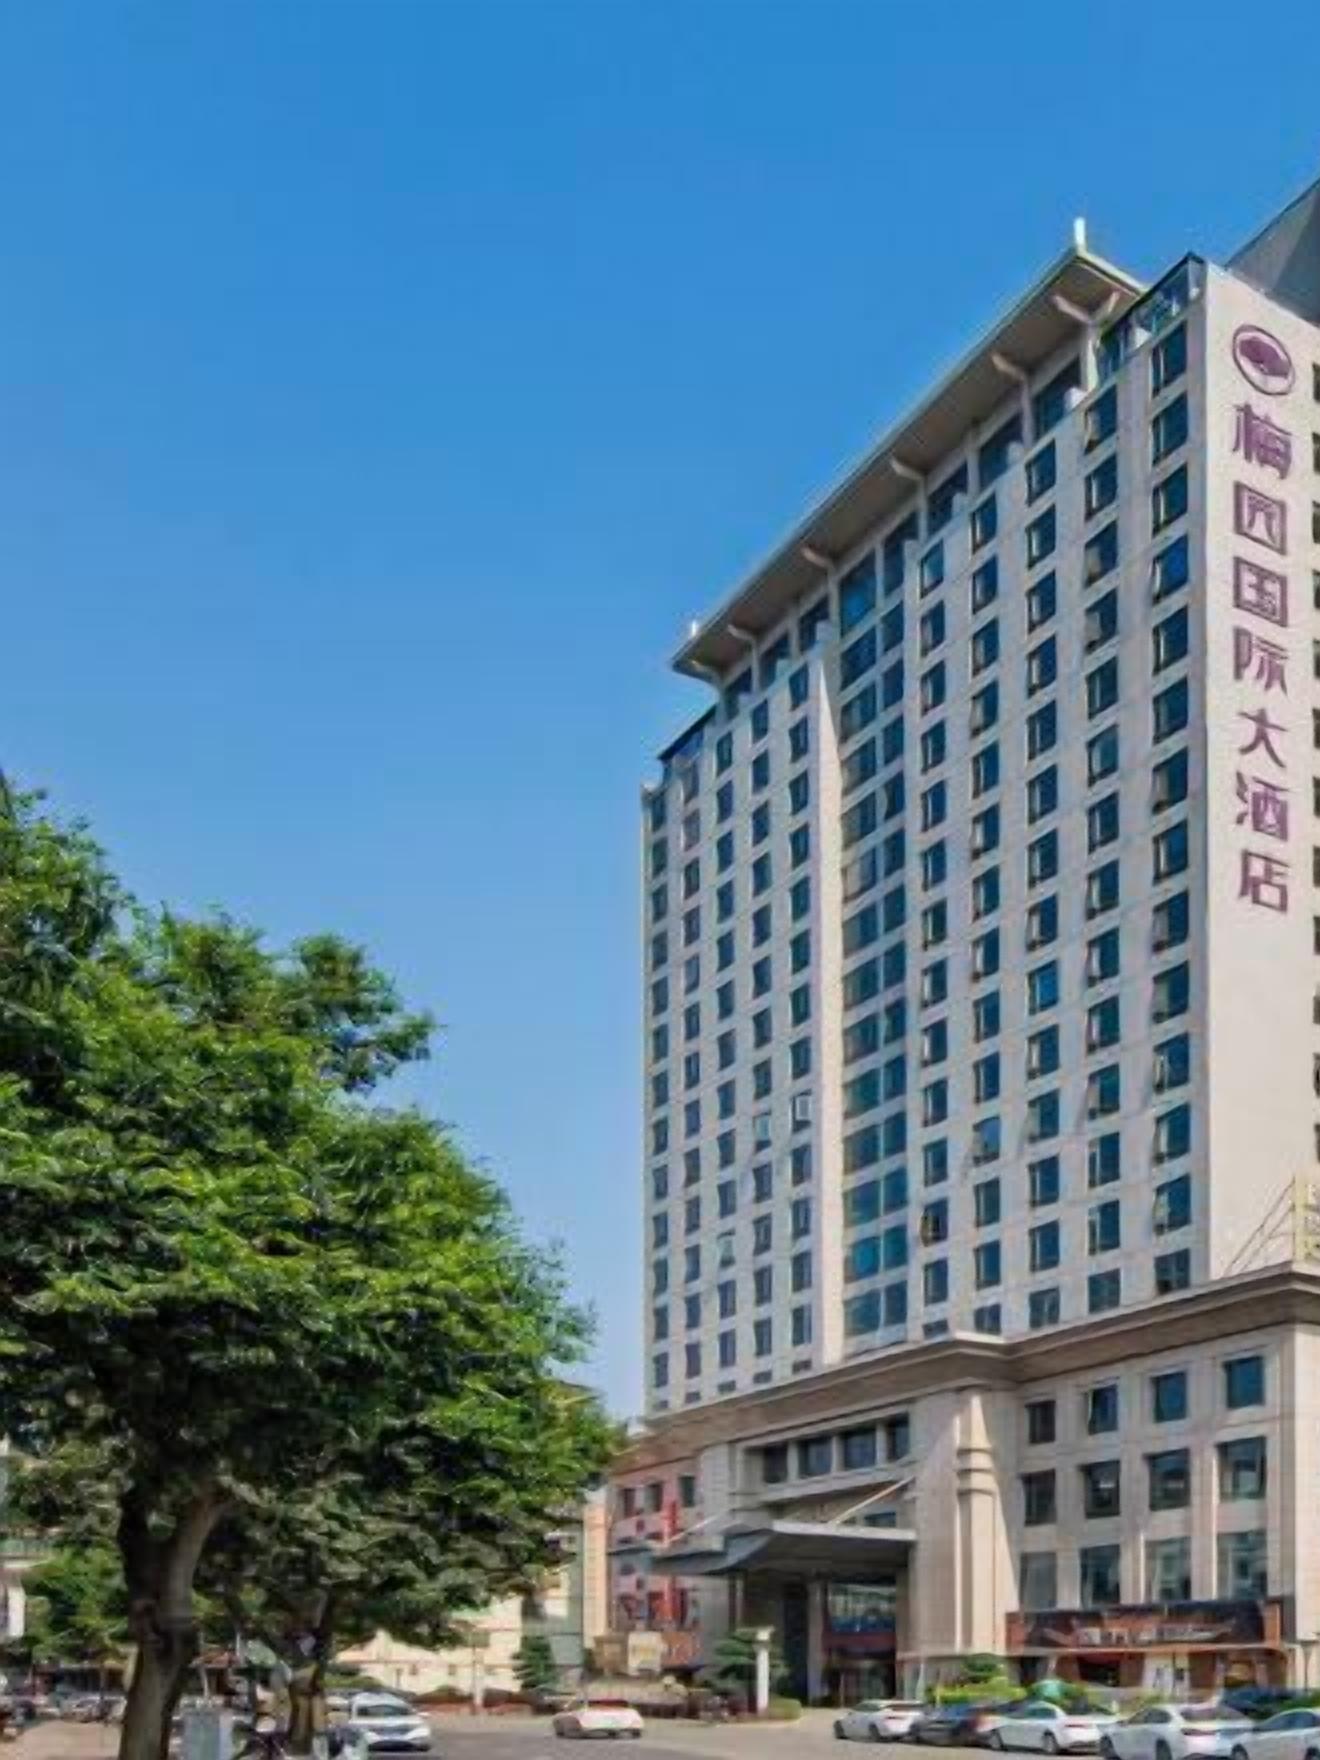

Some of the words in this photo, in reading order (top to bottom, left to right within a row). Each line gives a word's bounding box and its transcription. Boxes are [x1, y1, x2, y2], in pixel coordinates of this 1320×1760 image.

[1233, 403, 1291, 912] 梅园国际大酒店
